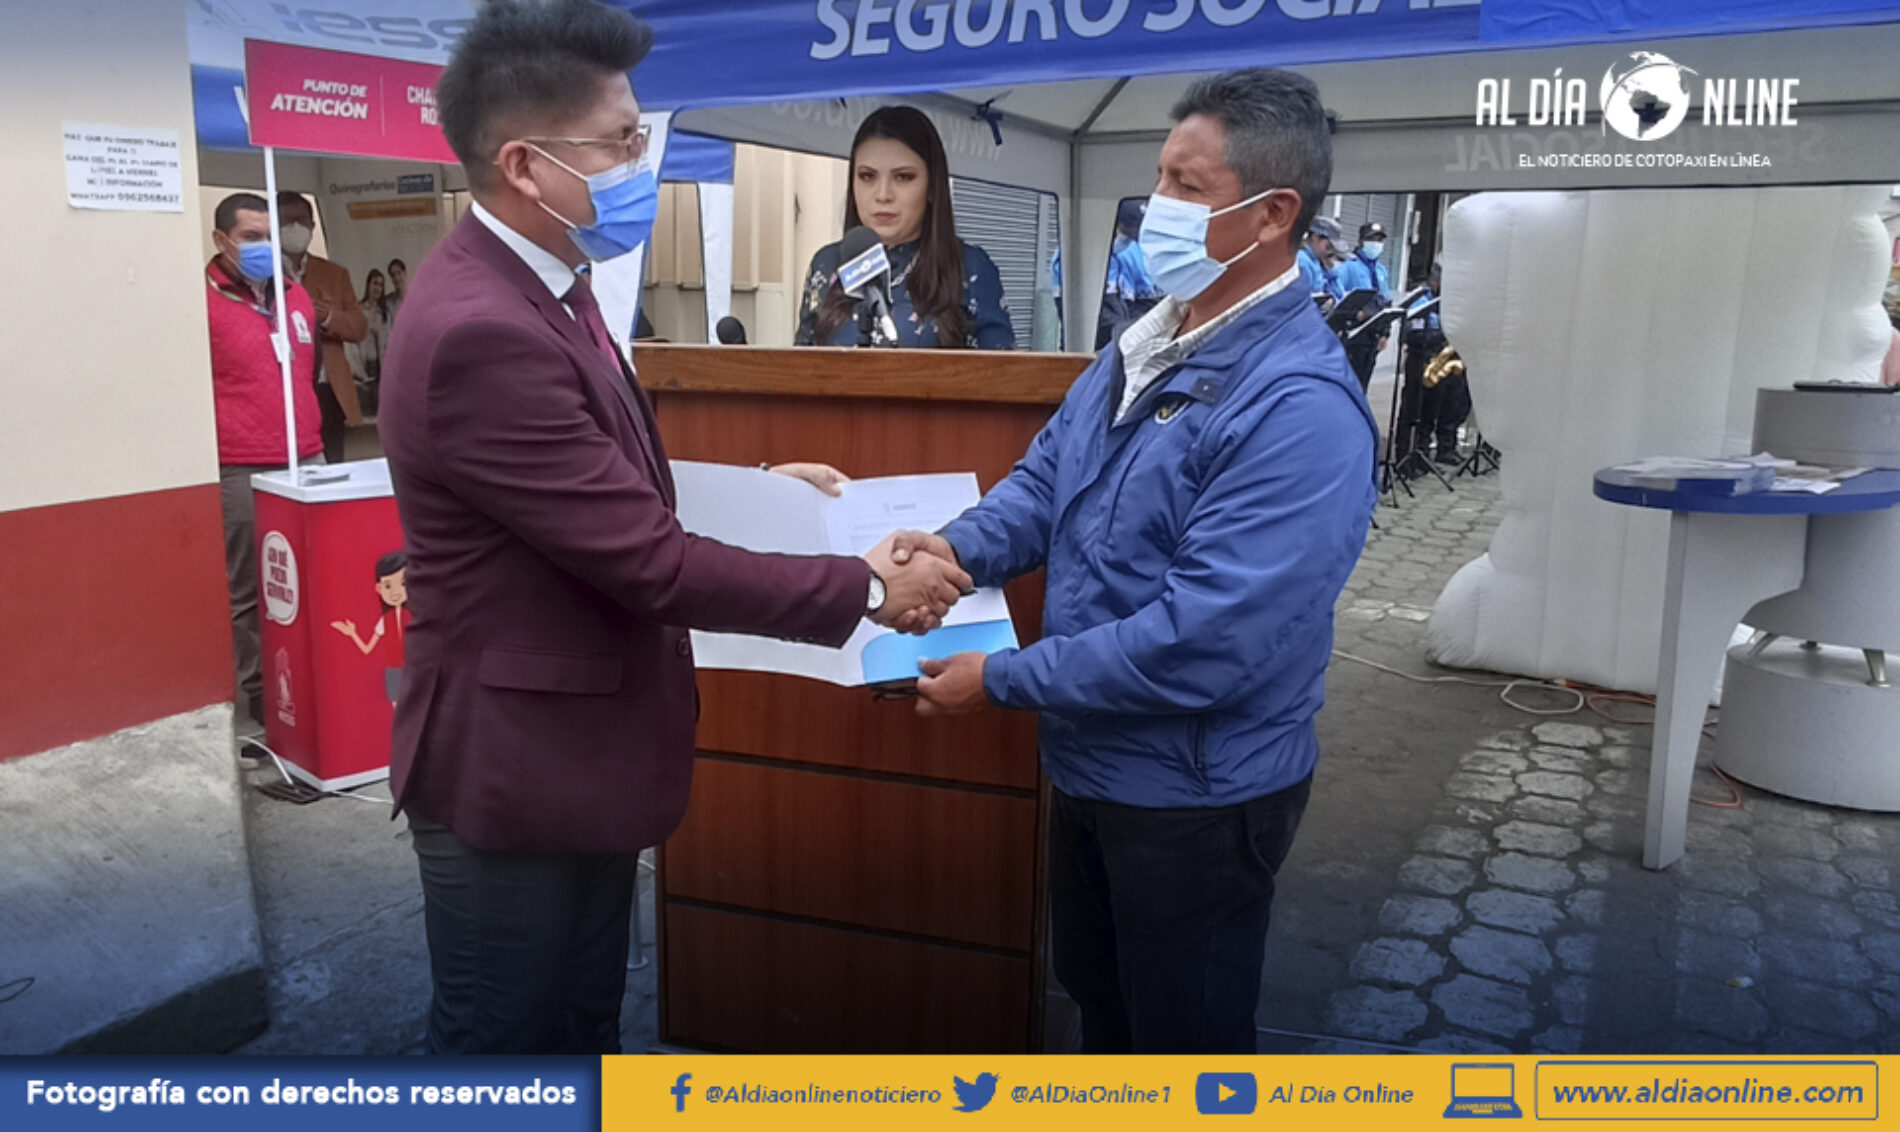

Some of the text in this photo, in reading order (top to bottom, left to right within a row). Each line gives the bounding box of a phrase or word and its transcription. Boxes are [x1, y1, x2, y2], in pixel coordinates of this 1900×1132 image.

[303, 79, 367, 97] PUNTO DE
[270, 93, 368, 120] ATENCIÓN
[420, 106, 442, 126] RO
